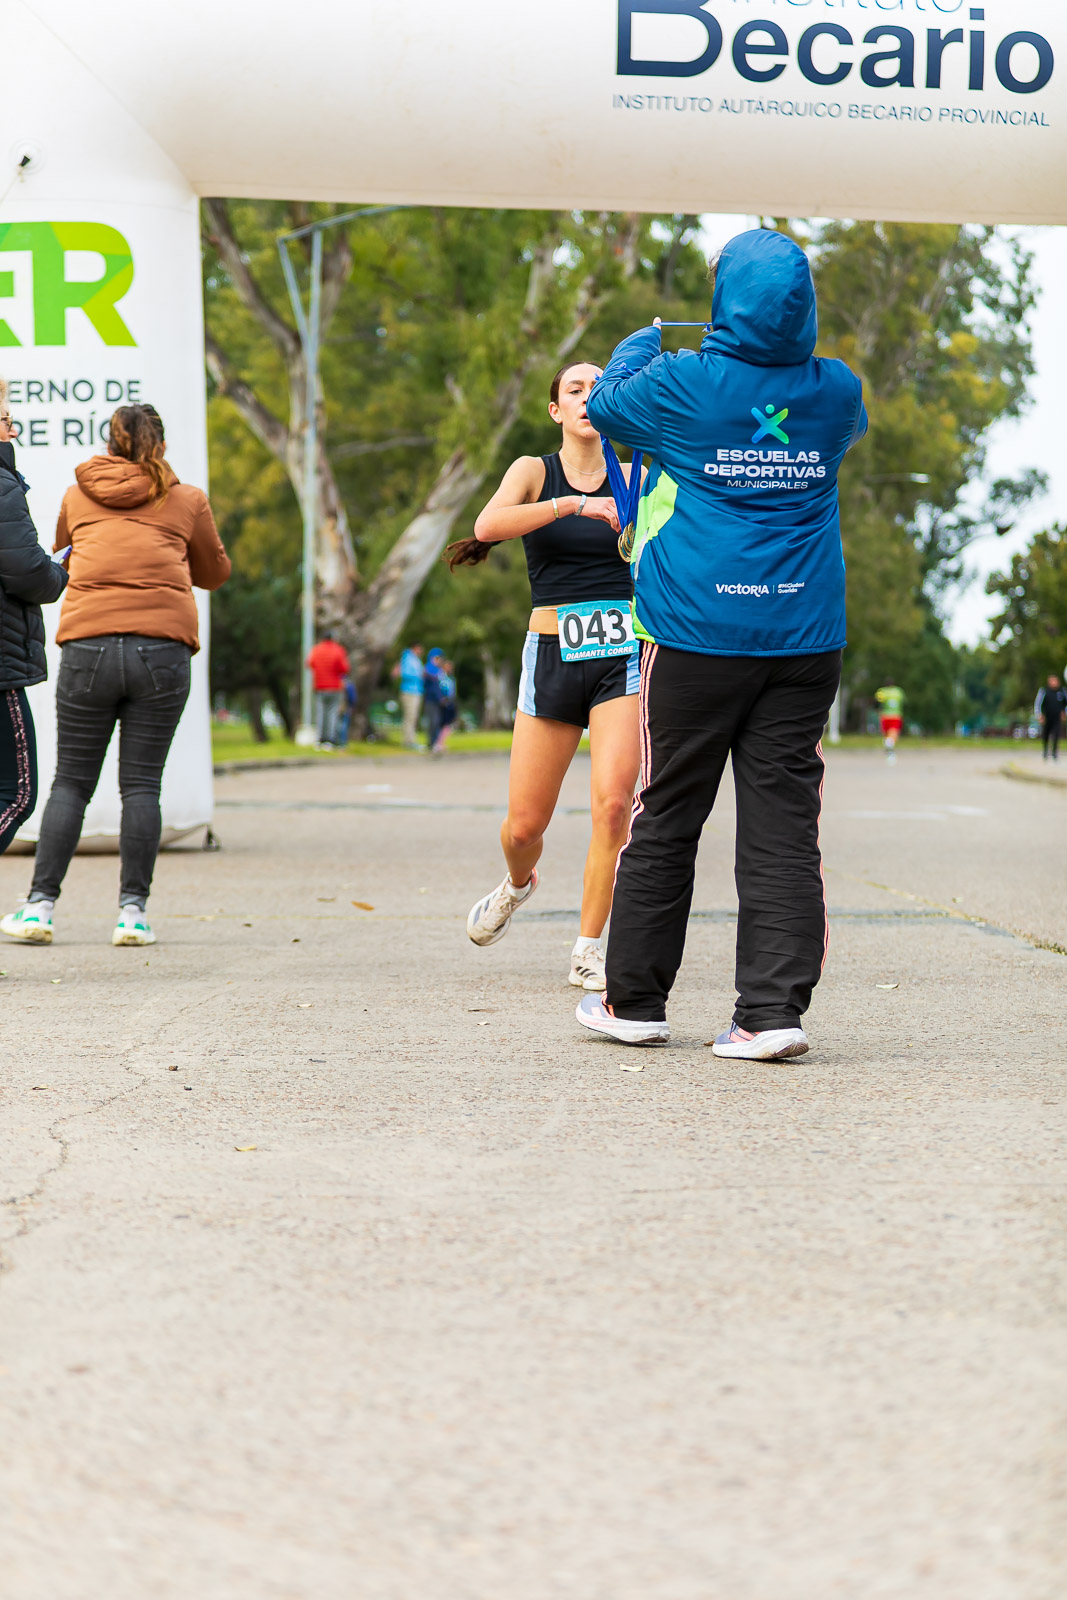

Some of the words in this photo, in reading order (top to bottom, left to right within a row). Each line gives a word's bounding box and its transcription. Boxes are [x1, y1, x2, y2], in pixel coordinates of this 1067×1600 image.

[616, 0, 1055, 94] Becario
[612, 94, 714, 113] INSTITUTO
[719, 97, 843, 118] AUTÁRQUICO
[847, 103, 933, 122] BECARIO
[938, 107, 1051, 127] PROVINCIAL
[8, 379, 94, 403] ERNO
[106, 380, 141, 402] DE
[716, 448, 820, 463] ESCUELAS
[703, 463, 826, 478] DEPORTIVAS
[726, 479, 809, 490] MUNICIPALES
[563, 608, 627, 650] 043
[566, 648, 606, 660] DIAMANTE
[607, 645, 634, 656] CORRE
